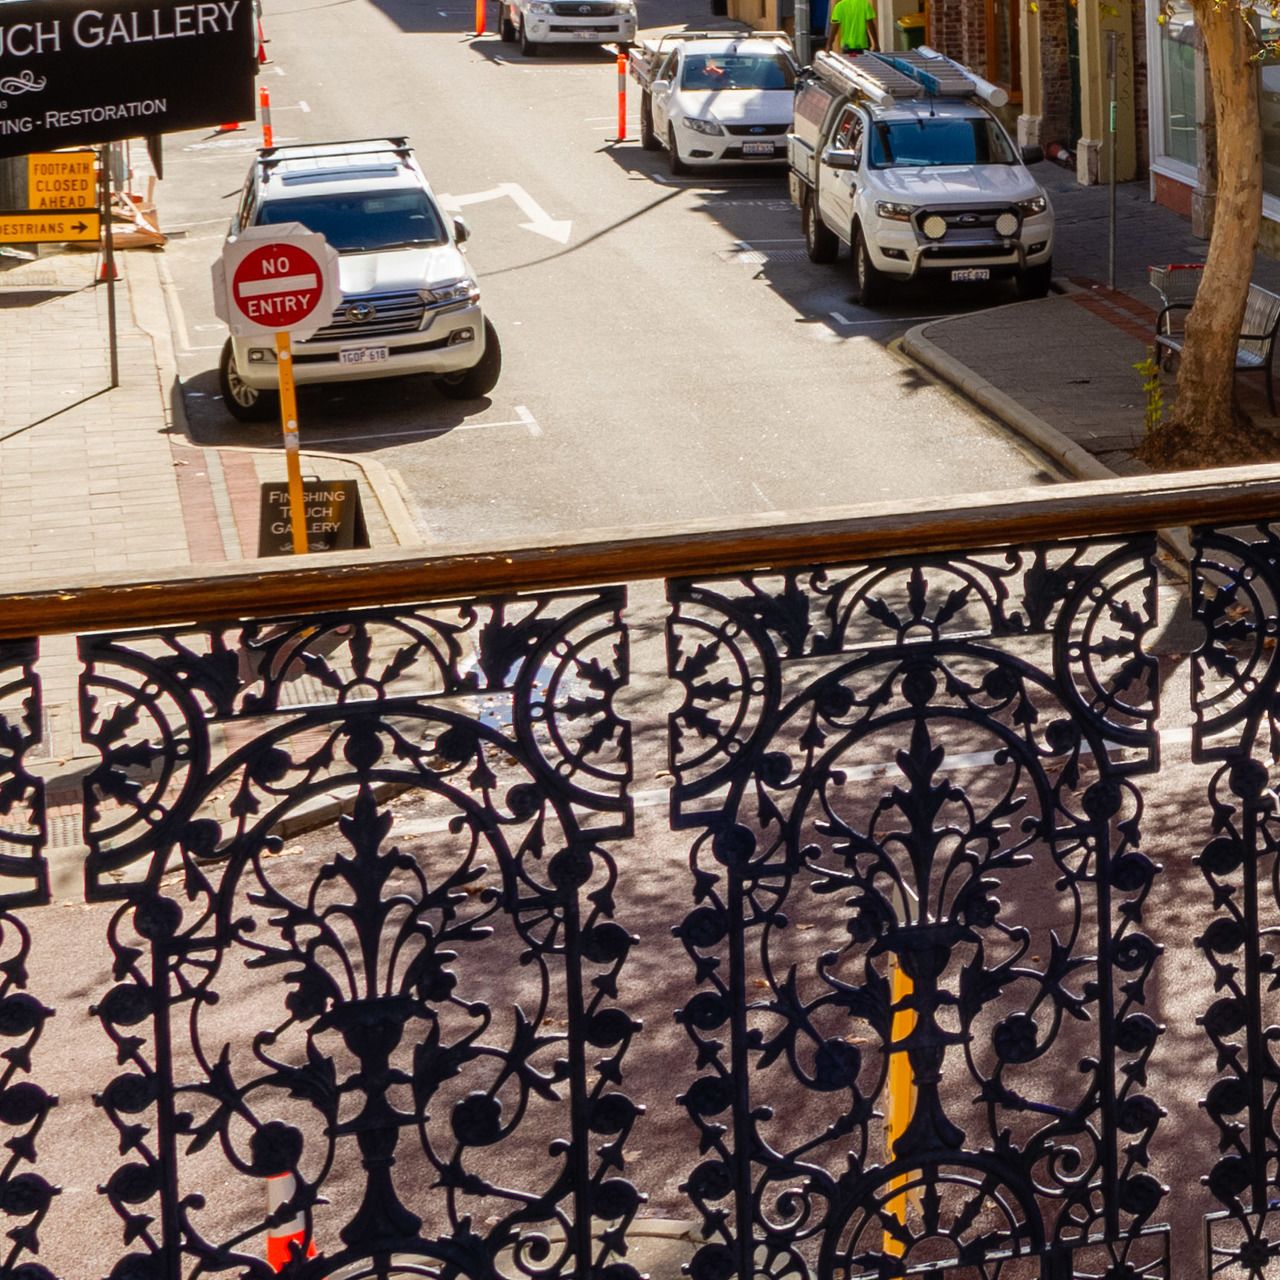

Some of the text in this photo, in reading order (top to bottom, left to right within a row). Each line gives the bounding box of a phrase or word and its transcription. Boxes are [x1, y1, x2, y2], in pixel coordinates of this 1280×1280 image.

[73, 0, 240, 48] GALLERY
[0, 98, 167, 135] ING RESTORATION
[33, 162, 90, 176] FOOTPATH
[36, 179, 88, 192] CLOSED
[39, 195, 86, 208] AHEAD
[0, 223, 64, 236] ESTRIANS
[261, 257, 290, 275] NO
[248, 294, 311, 316] ENTRY
[268, 490, 346, 504] FINSHING
